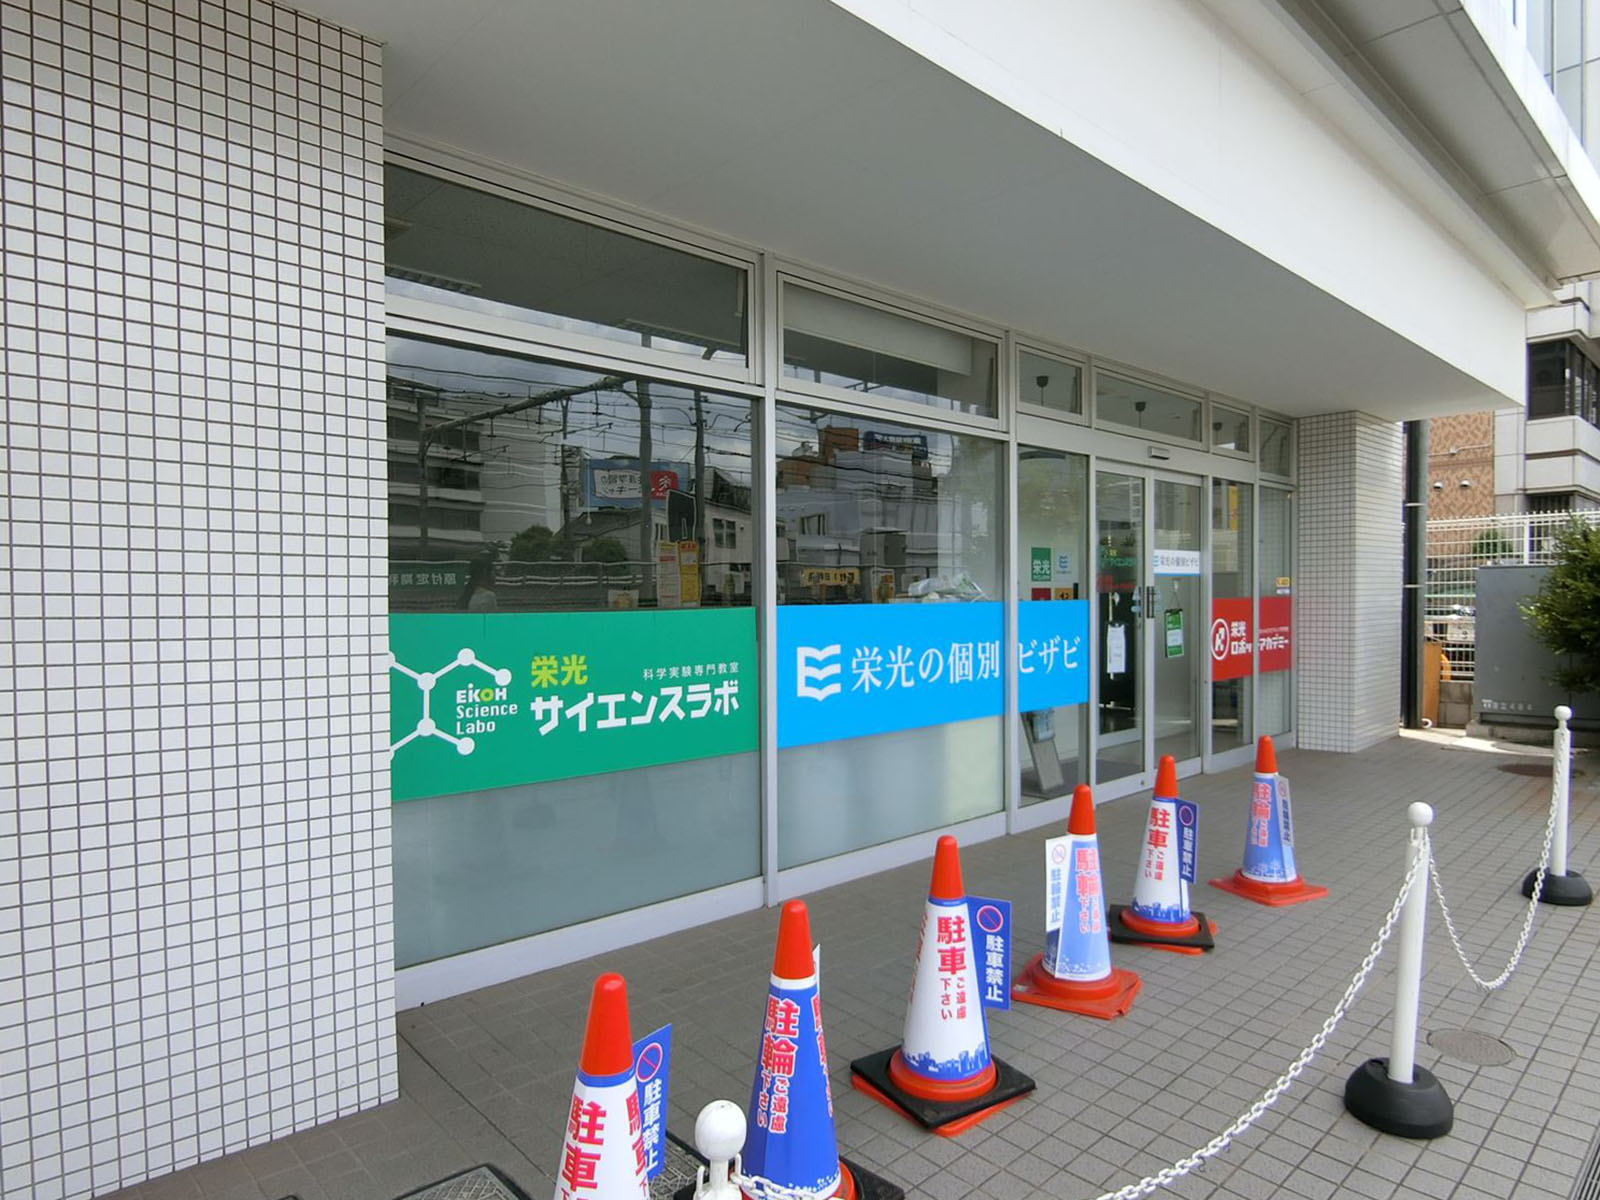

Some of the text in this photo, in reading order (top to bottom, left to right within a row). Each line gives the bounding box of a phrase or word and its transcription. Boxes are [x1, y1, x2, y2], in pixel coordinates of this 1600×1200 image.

[530, 653, 588, 689] 栄光
[643, 661, 739, 680] 科学実験専門教室
[851, 640, 1000, 693] 栄光の個別
[1018, 635, 1081, 674] ビザビ
[456, 703, 518, 719] Science
[456, 719, 496, 735] Labo
[530, 680, 739, 736] サイエンスラボ
[1148, 807, 1171, 849] 駐車
[936, 915, 967, 975] 駐車
[984, 933, 1005, 1003] 駐車禁止
[940, 977, 953, 1020] 下さい
[762, 994, 800, 1077] 駐輪
[561, 1093, 607, 1192] 駐車
